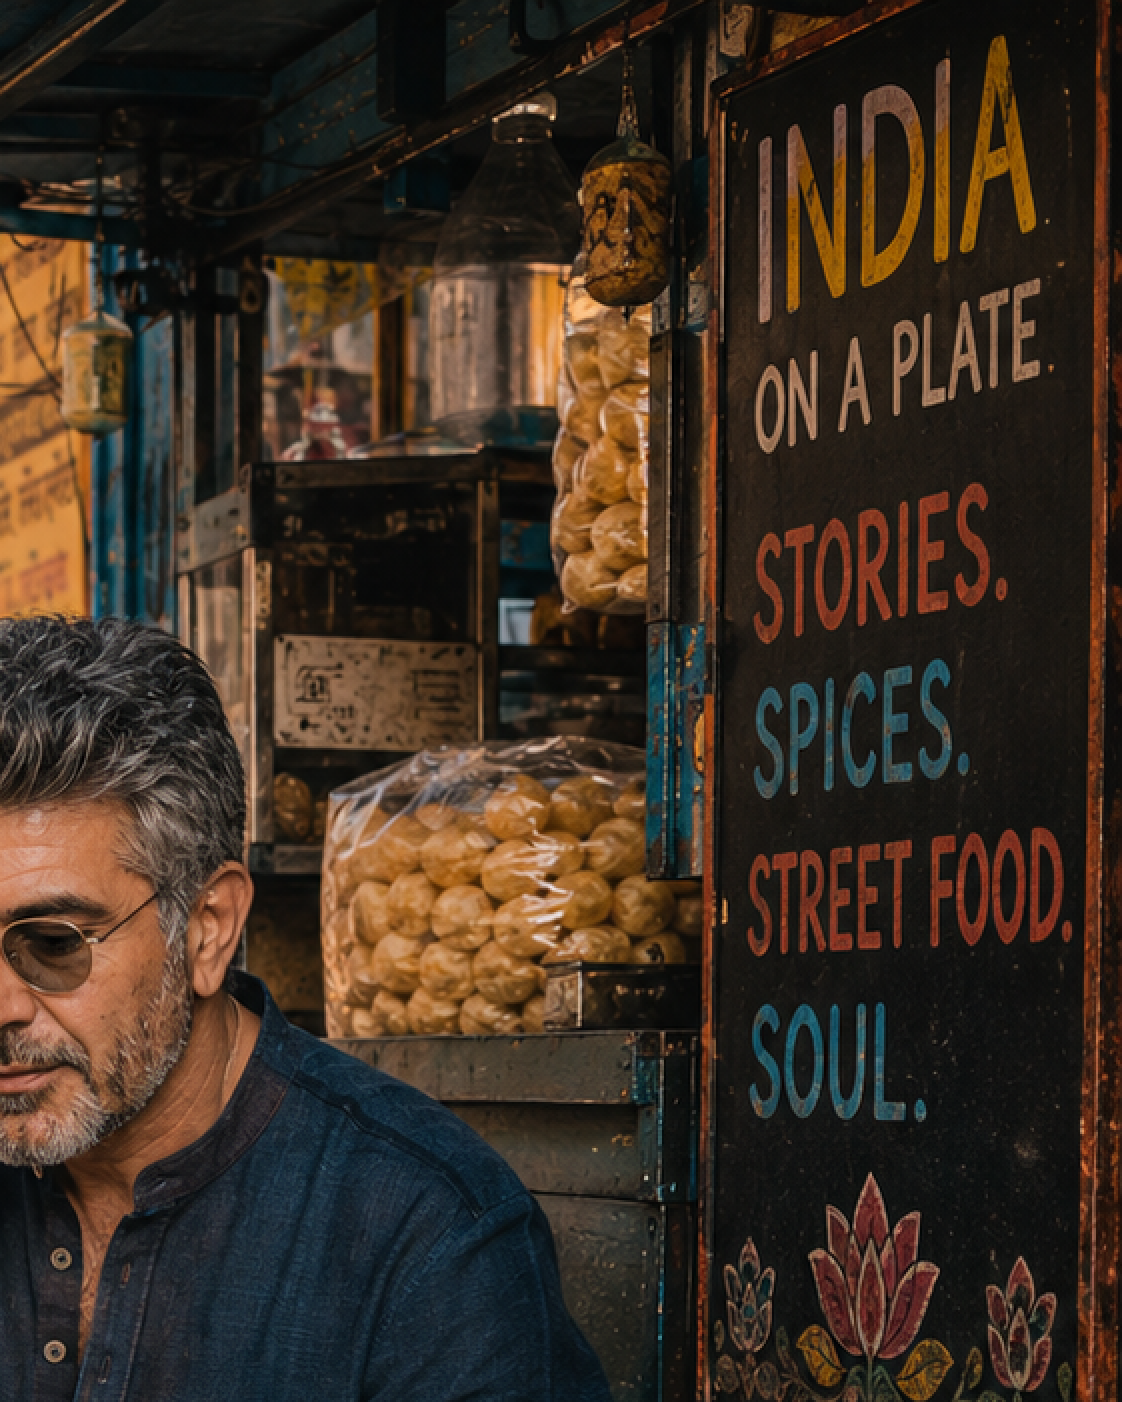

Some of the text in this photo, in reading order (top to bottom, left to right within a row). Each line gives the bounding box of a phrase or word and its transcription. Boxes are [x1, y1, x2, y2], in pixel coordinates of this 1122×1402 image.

[758, 35, 1037, 325] INDIA
[755, 350, 819, 454] ON
[837, 336, 872, 433] A
[753, 482, 1009, 644] STORIES.
[753, 658, 971, 799] SPICES.
[747, 827, 1073, 957] STREET FOOD.
[749, 1002, 927, 1122] SOUL.
